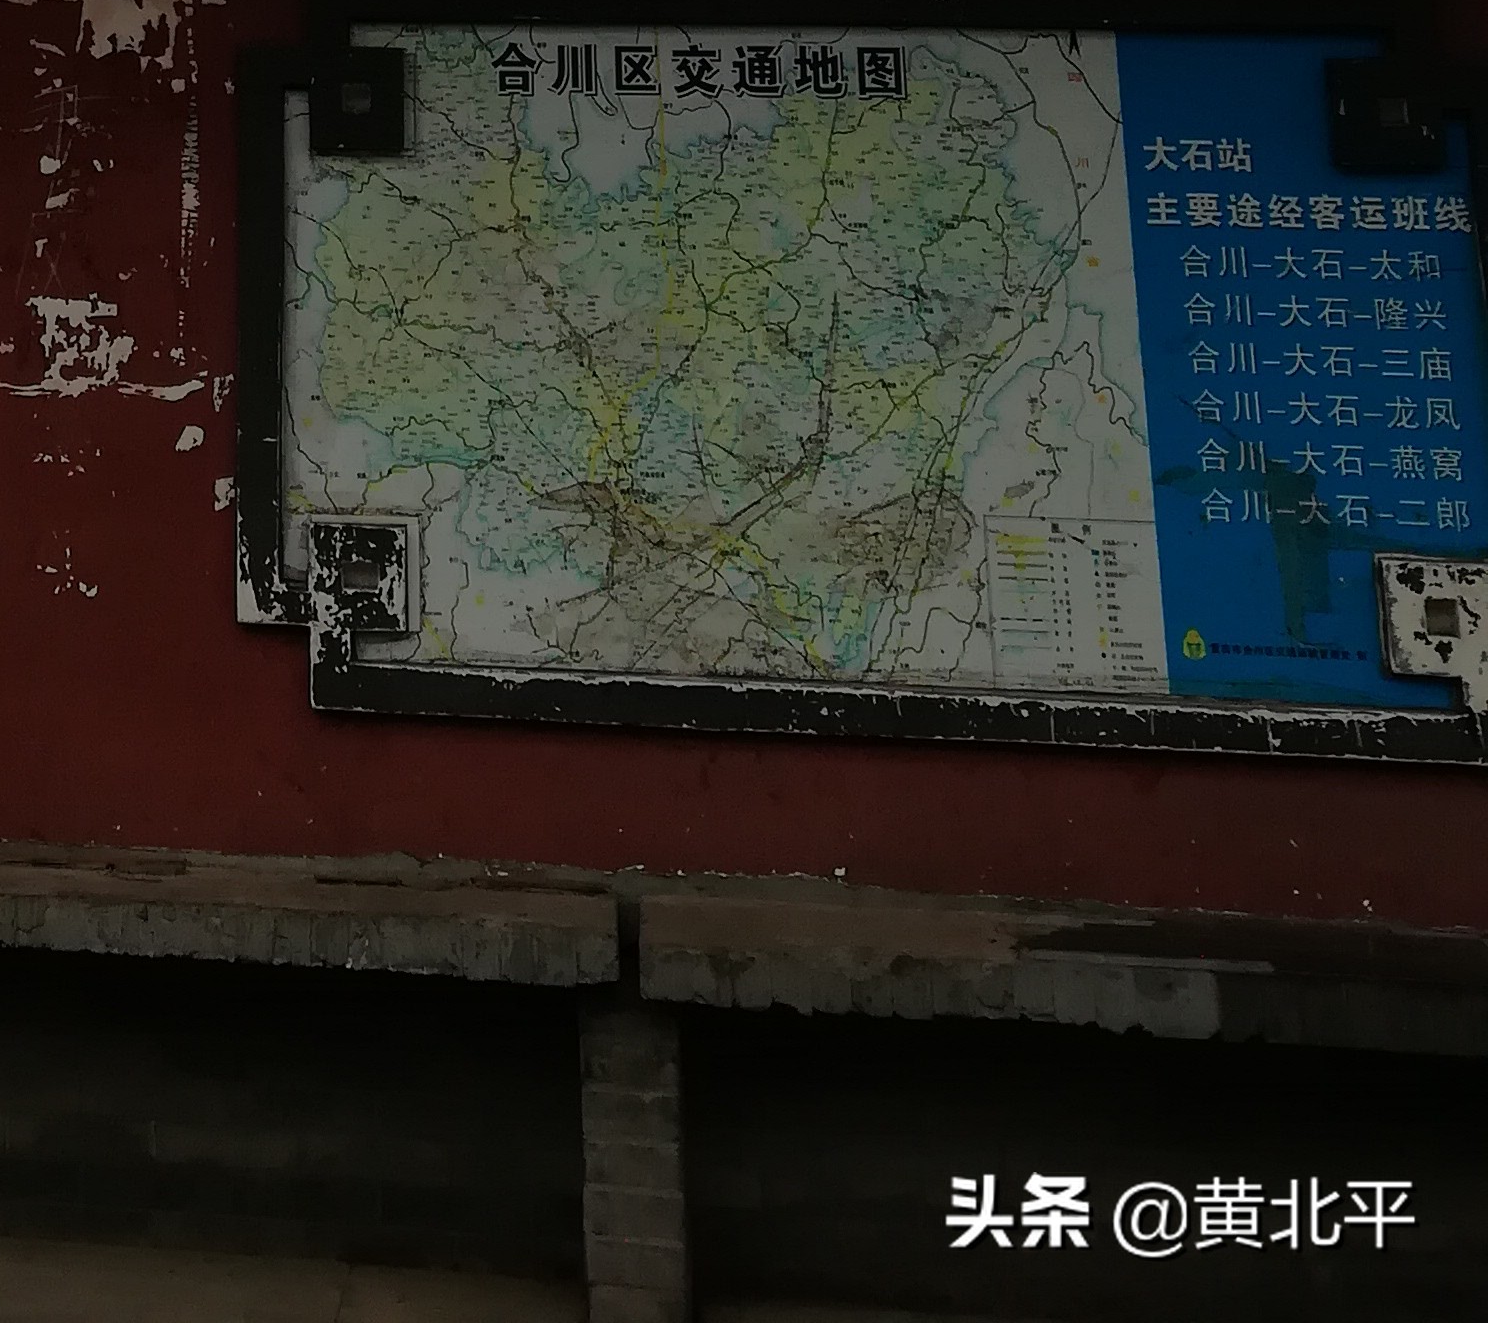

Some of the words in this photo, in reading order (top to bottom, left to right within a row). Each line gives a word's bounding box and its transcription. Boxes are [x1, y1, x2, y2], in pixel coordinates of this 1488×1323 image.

[491, 42, 909, 100] 合川区交通地图
[1143, 136, 1253, 174] 大石站
[1146, 192, 1473, 234] 主要途经客运班线
